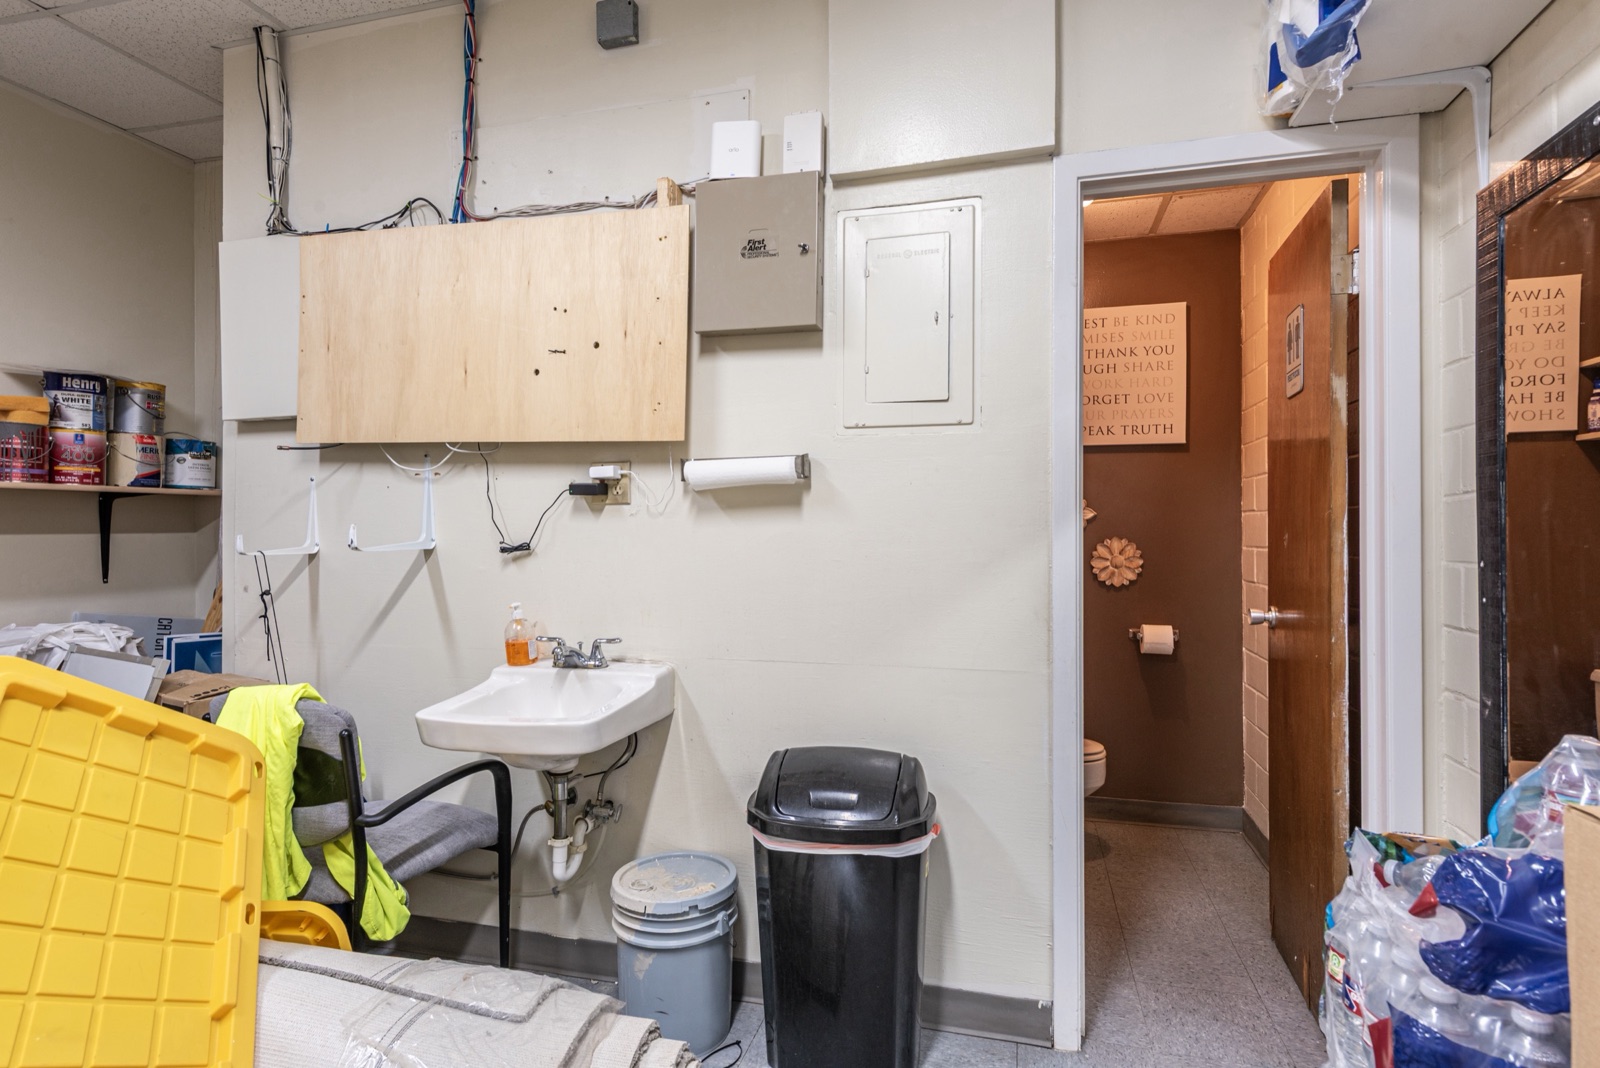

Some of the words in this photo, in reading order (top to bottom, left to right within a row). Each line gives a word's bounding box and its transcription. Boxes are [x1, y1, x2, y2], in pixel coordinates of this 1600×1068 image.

[747, 238, 765, 246] First
[747, 244, 767, 252] Alert
[1084, 317, 1108, 329] EST
[1113, 316, 1129, 327] BE
[1135, 313, 1176, 326] KIND
[1083, 331, 1124, 344] MISES
[1131, 329, 1175, 342] SMILE
[1085, 346, 1138, 360] THANK
[1143, 344, 1175, 356] YOU
[1083, 363, 1117, 375] UGH
[1123, 360, 1174, 373] SHARE
[62, 376, 101, 393] Henry
[1129, 376, 1174, 388] HARD
[61, 396, 92, 405] WHITE
[1137, 392, 1174, 404] LOVE
[1085, 410, 1106, 421] UR
[1112, 408, 1174, 420] PRAYERS
[1120, 423, 1174, 436] TRUTH
[61, 448, 95, 463] 400
